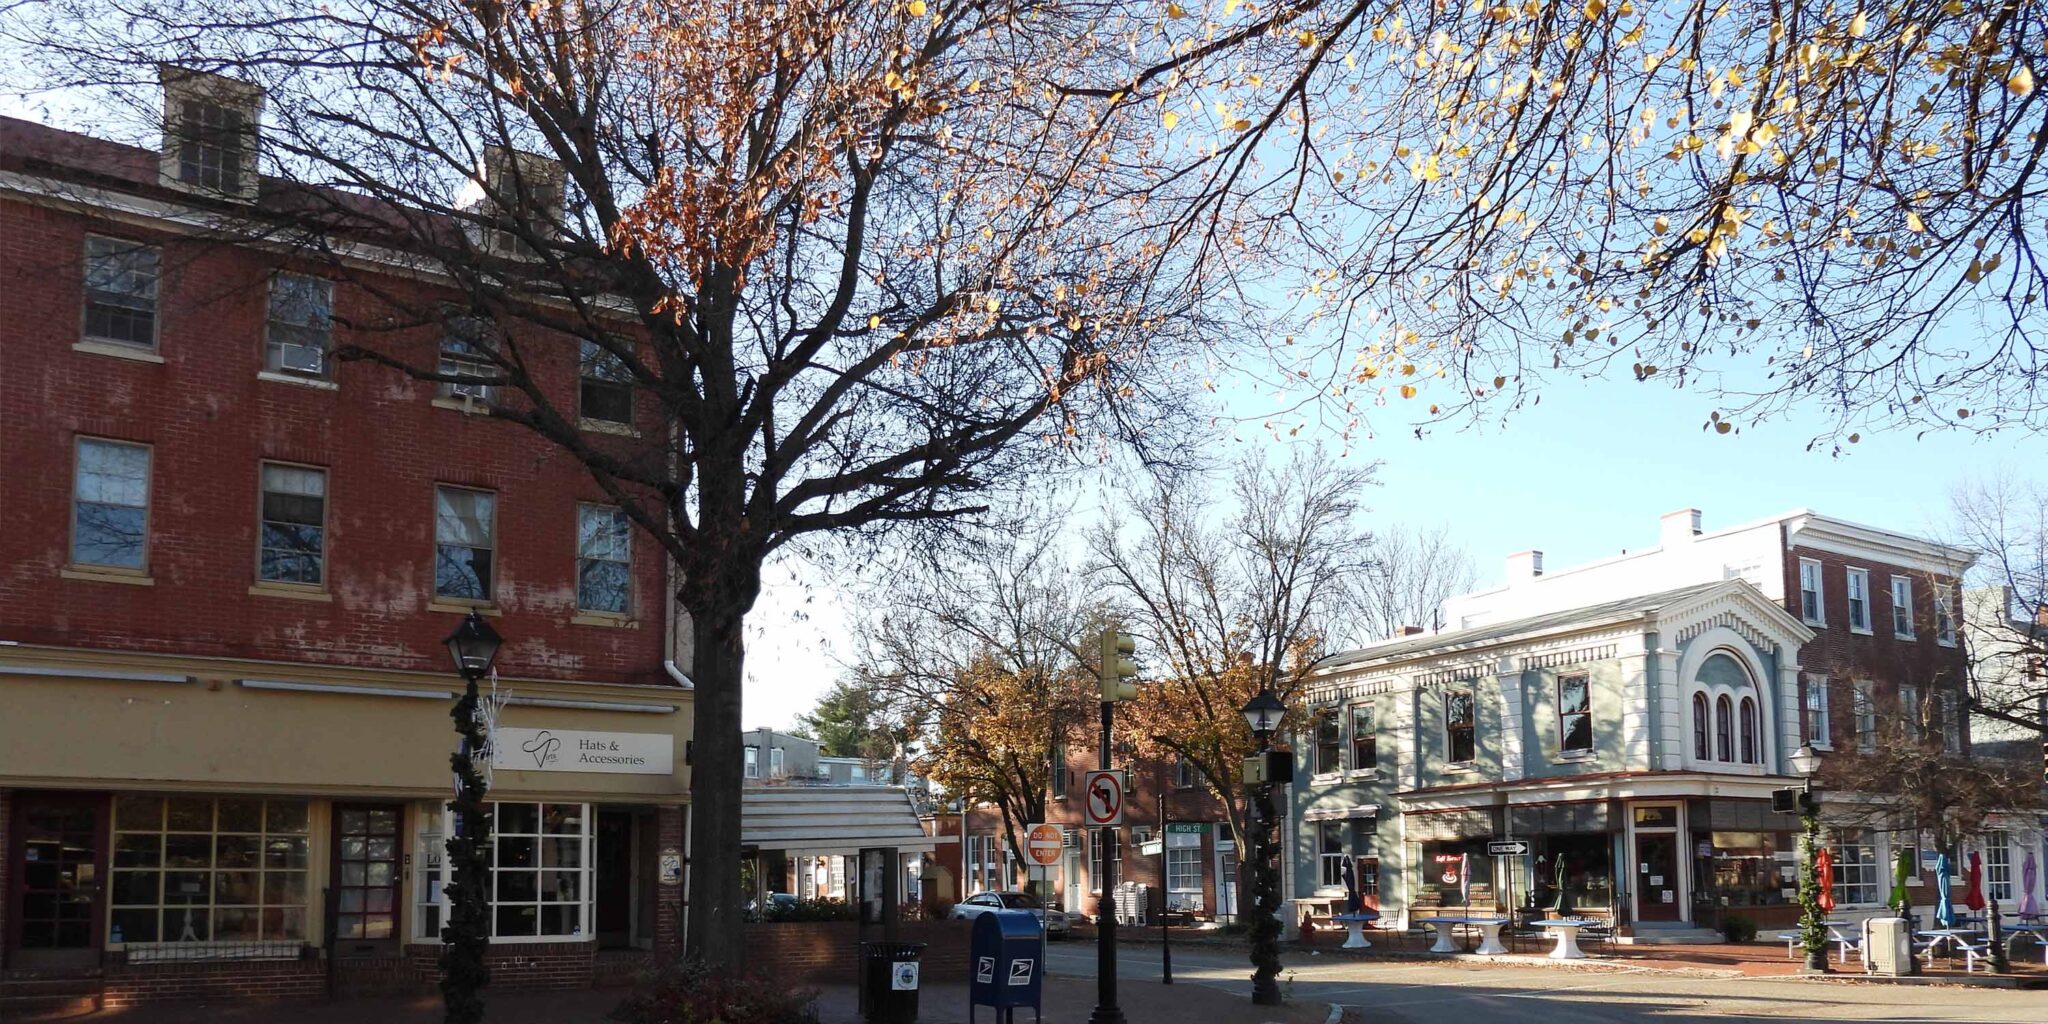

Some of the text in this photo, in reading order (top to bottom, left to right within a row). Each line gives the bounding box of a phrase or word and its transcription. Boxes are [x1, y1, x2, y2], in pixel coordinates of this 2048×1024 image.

[579, 739, 620, 751] Hats &
[578, 753, 645, 765] Accessories
[1175, 825, 1191, 833] HIGH
